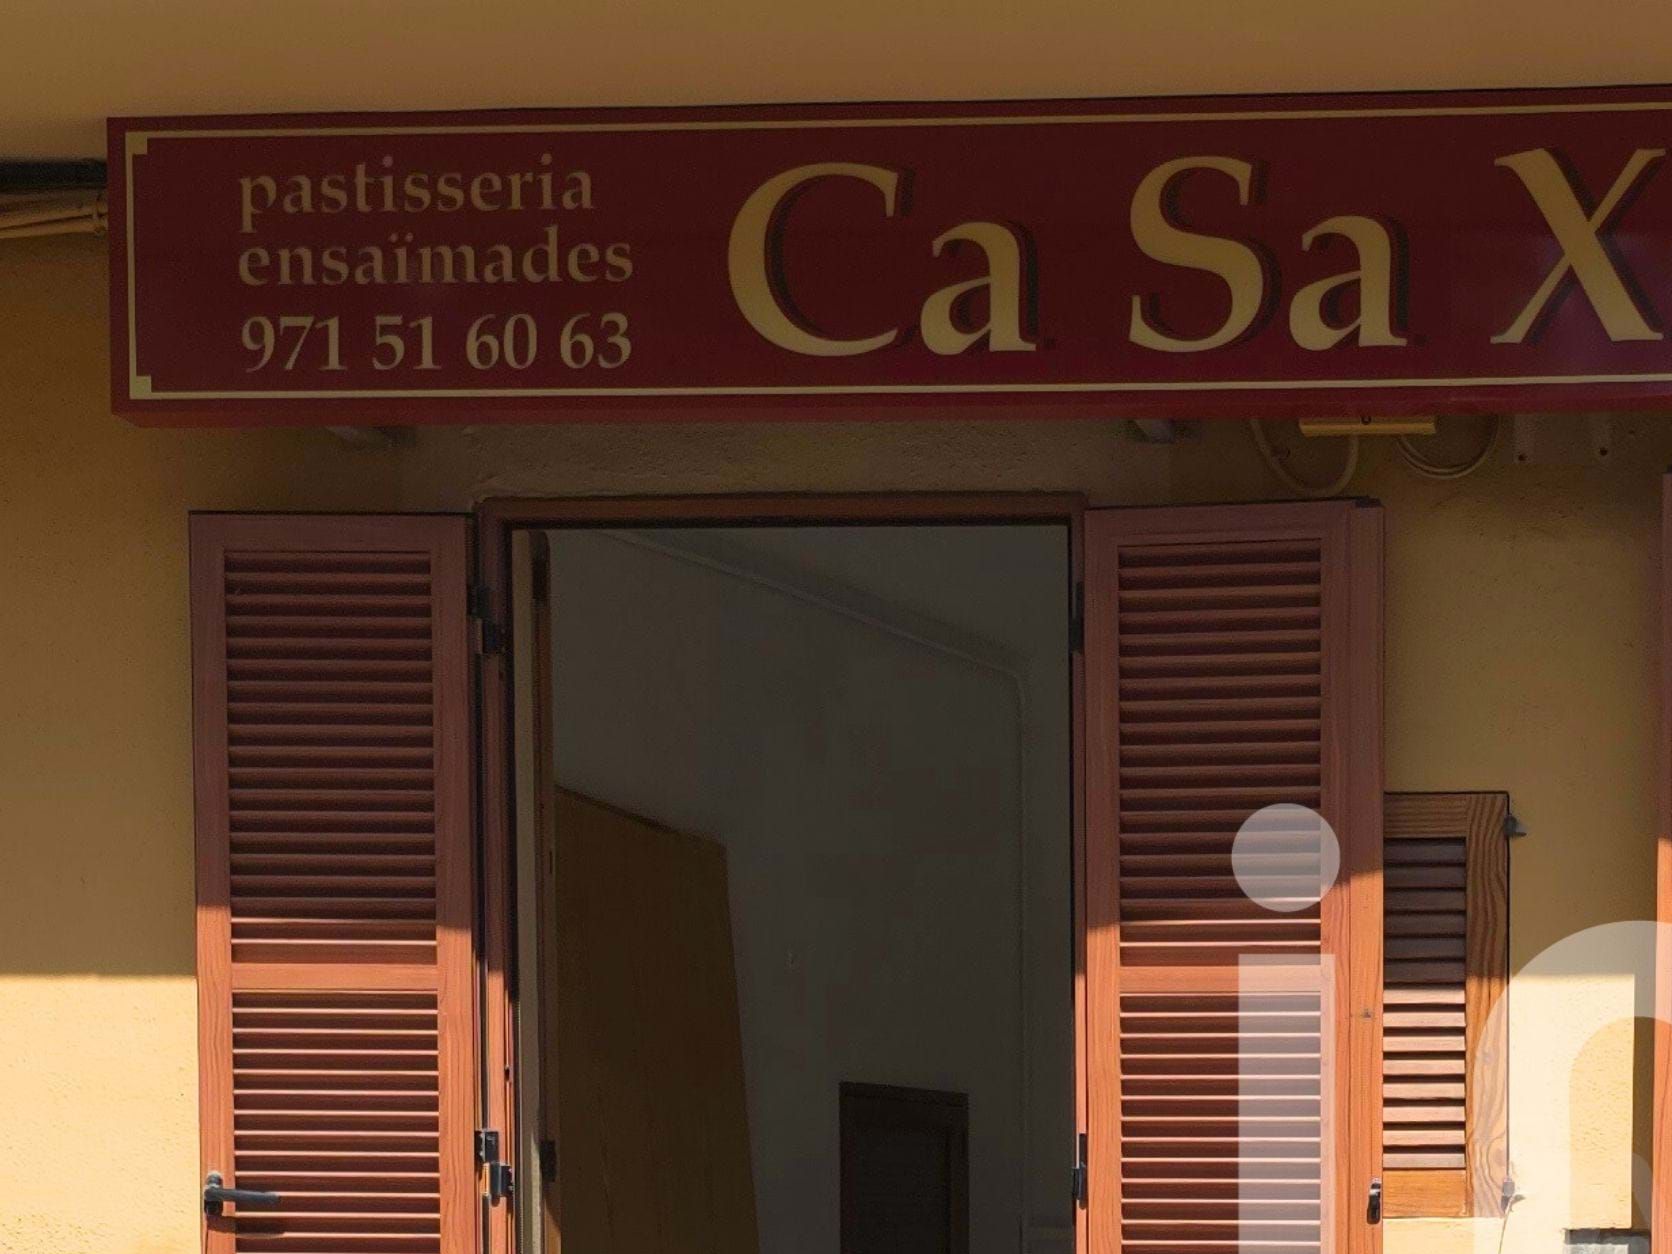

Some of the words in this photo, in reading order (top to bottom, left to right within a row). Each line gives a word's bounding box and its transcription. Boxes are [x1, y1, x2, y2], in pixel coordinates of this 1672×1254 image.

[239, 153, 594, 234] pastisseria
[238, 223, 633, 286] ensaïmades
[727, 161, 1040, 358] Ca
[1126, 153, 1410, 354] Sa
[241, 315, 347, 373] 971
[372, 315, 442, 371] 51
[465, 313, 537, 370] 60
[560, 311, 632, 370] 63
